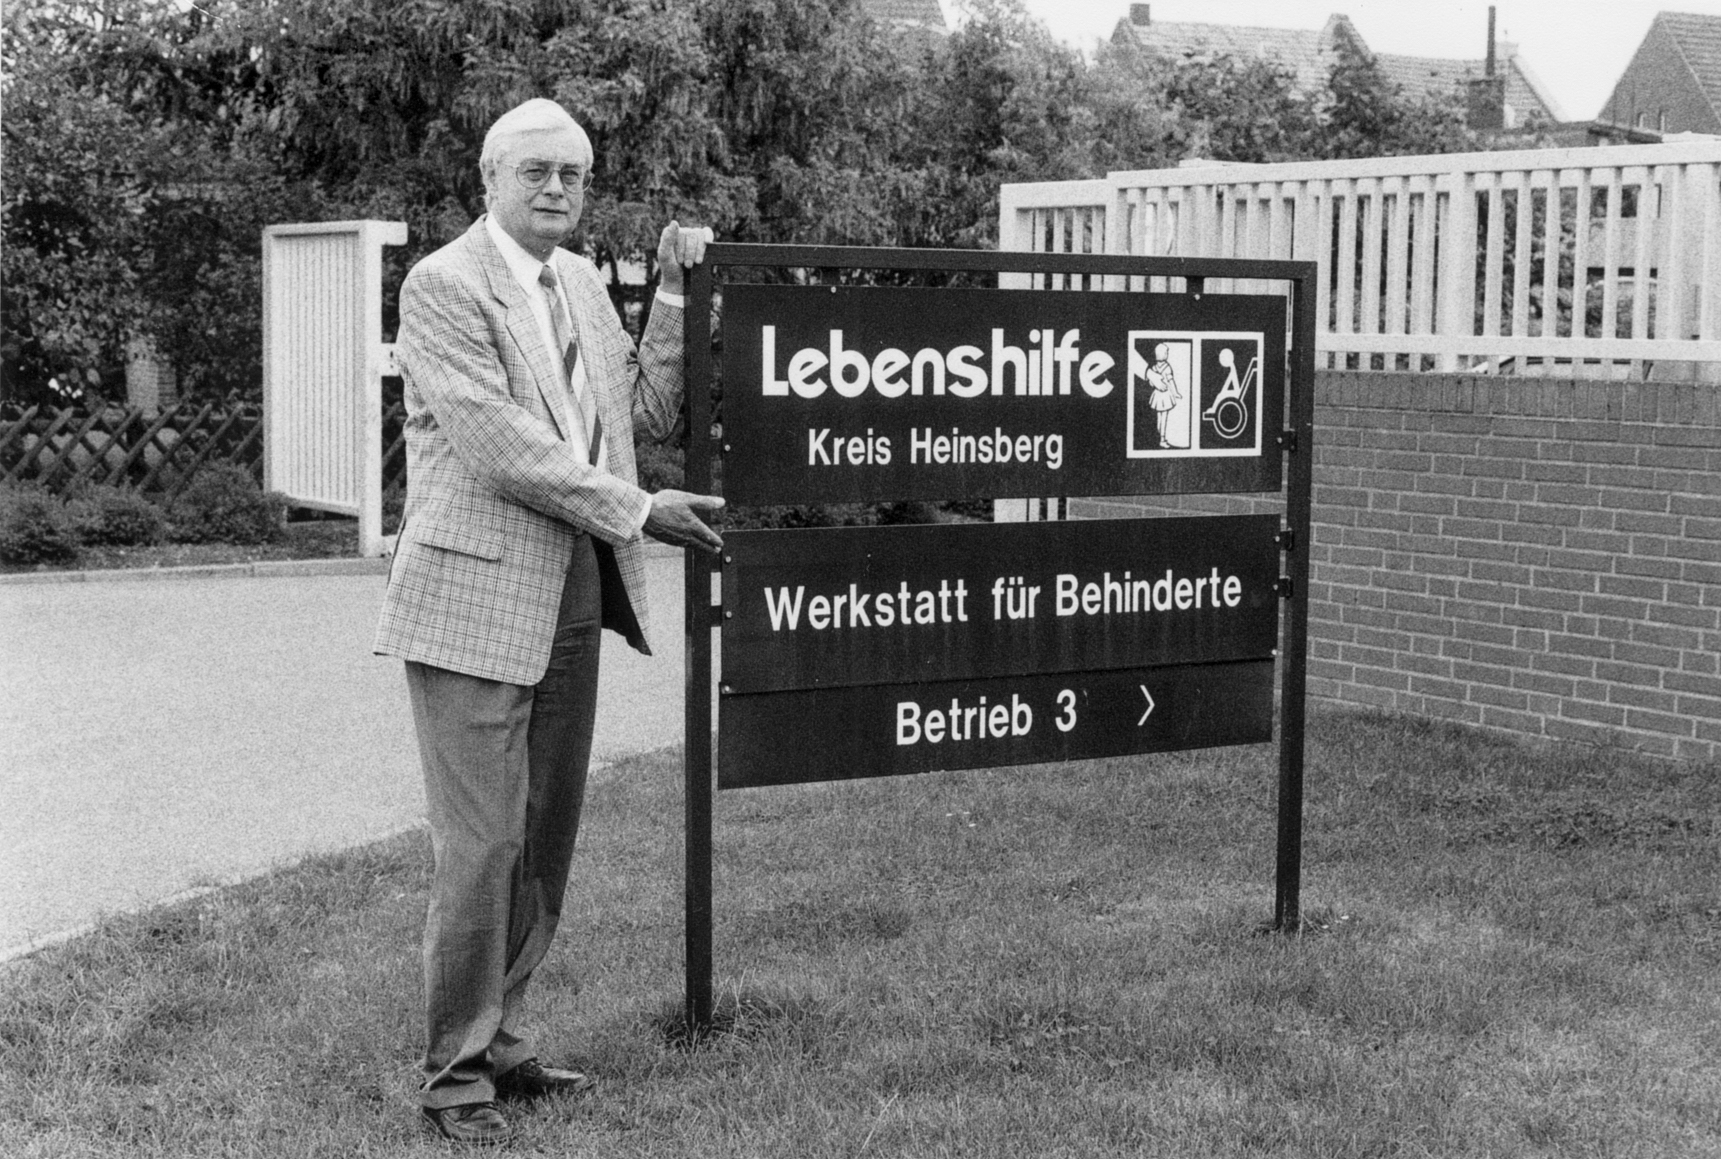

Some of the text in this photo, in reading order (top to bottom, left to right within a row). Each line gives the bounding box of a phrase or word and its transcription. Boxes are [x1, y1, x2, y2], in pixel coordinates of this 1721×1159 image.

[762, 325, 1116, 399] Lebenshilfe
[808, 427, 1063, 470] Kreis Heinsberg
[764, 567, 1243, 632] Werkstatt für Behinderte
[896, 689, 1077, 746] Betrieb 3
